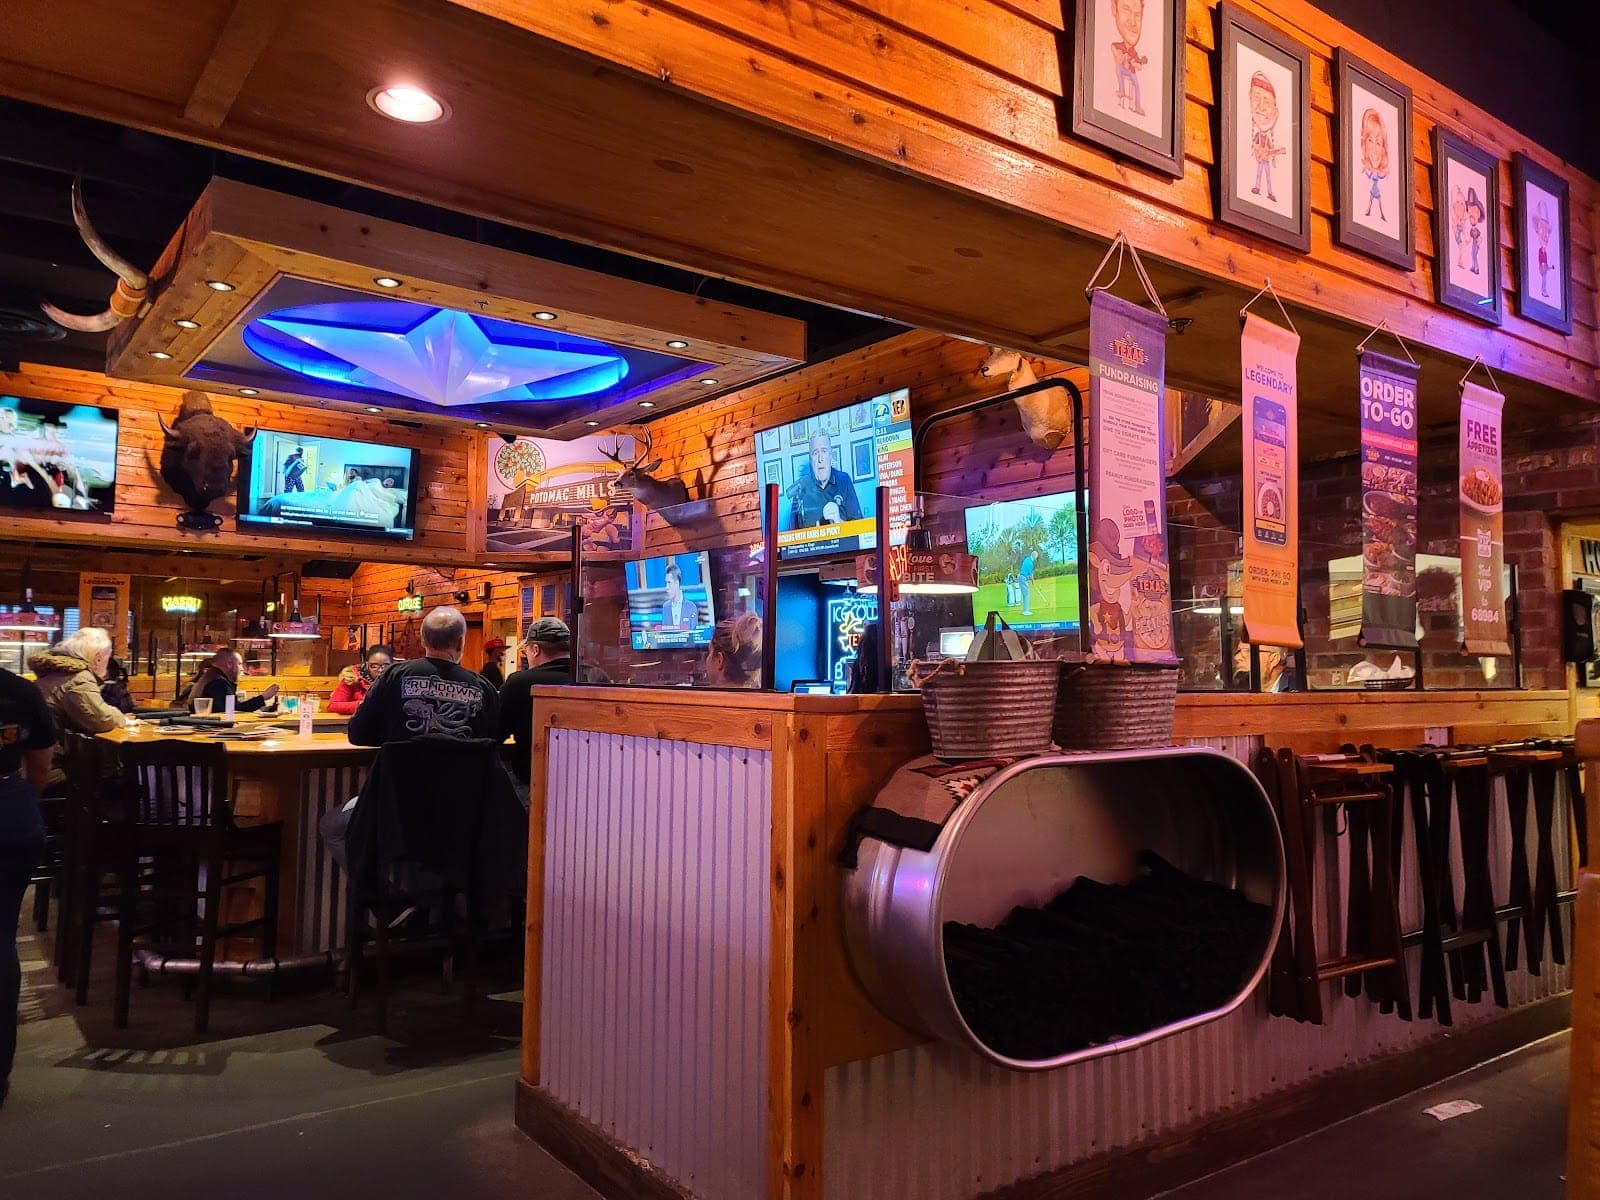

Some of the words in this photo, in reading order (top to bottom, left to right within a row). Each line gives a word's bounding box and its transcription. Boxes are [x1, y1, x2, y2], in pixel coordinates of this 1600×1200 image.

[1114, 341, 1145, 363] TEXAS
[1099, 364, 1158, 393] FUNDRAISING
[1245, 368, 1293, 395] LEGENDARY
[1361, 376, 1415, 409] ORDER
[1361, 399, 1414, 430] TO-GO
[1467, 419, 1497, 446] FREE
[1467, 439, 1498, 457] APPETIZER
[530, 487, 570, 504] POTOMAC
[577, 480, 617, 499] MILLS
[1123, 508, 1138, 516] LOGO
[903, 573, 935, 583] BITE
[1139, 579, 1166, 593] TEXAS
[410, 681, 477, 699] RUNDOWN
